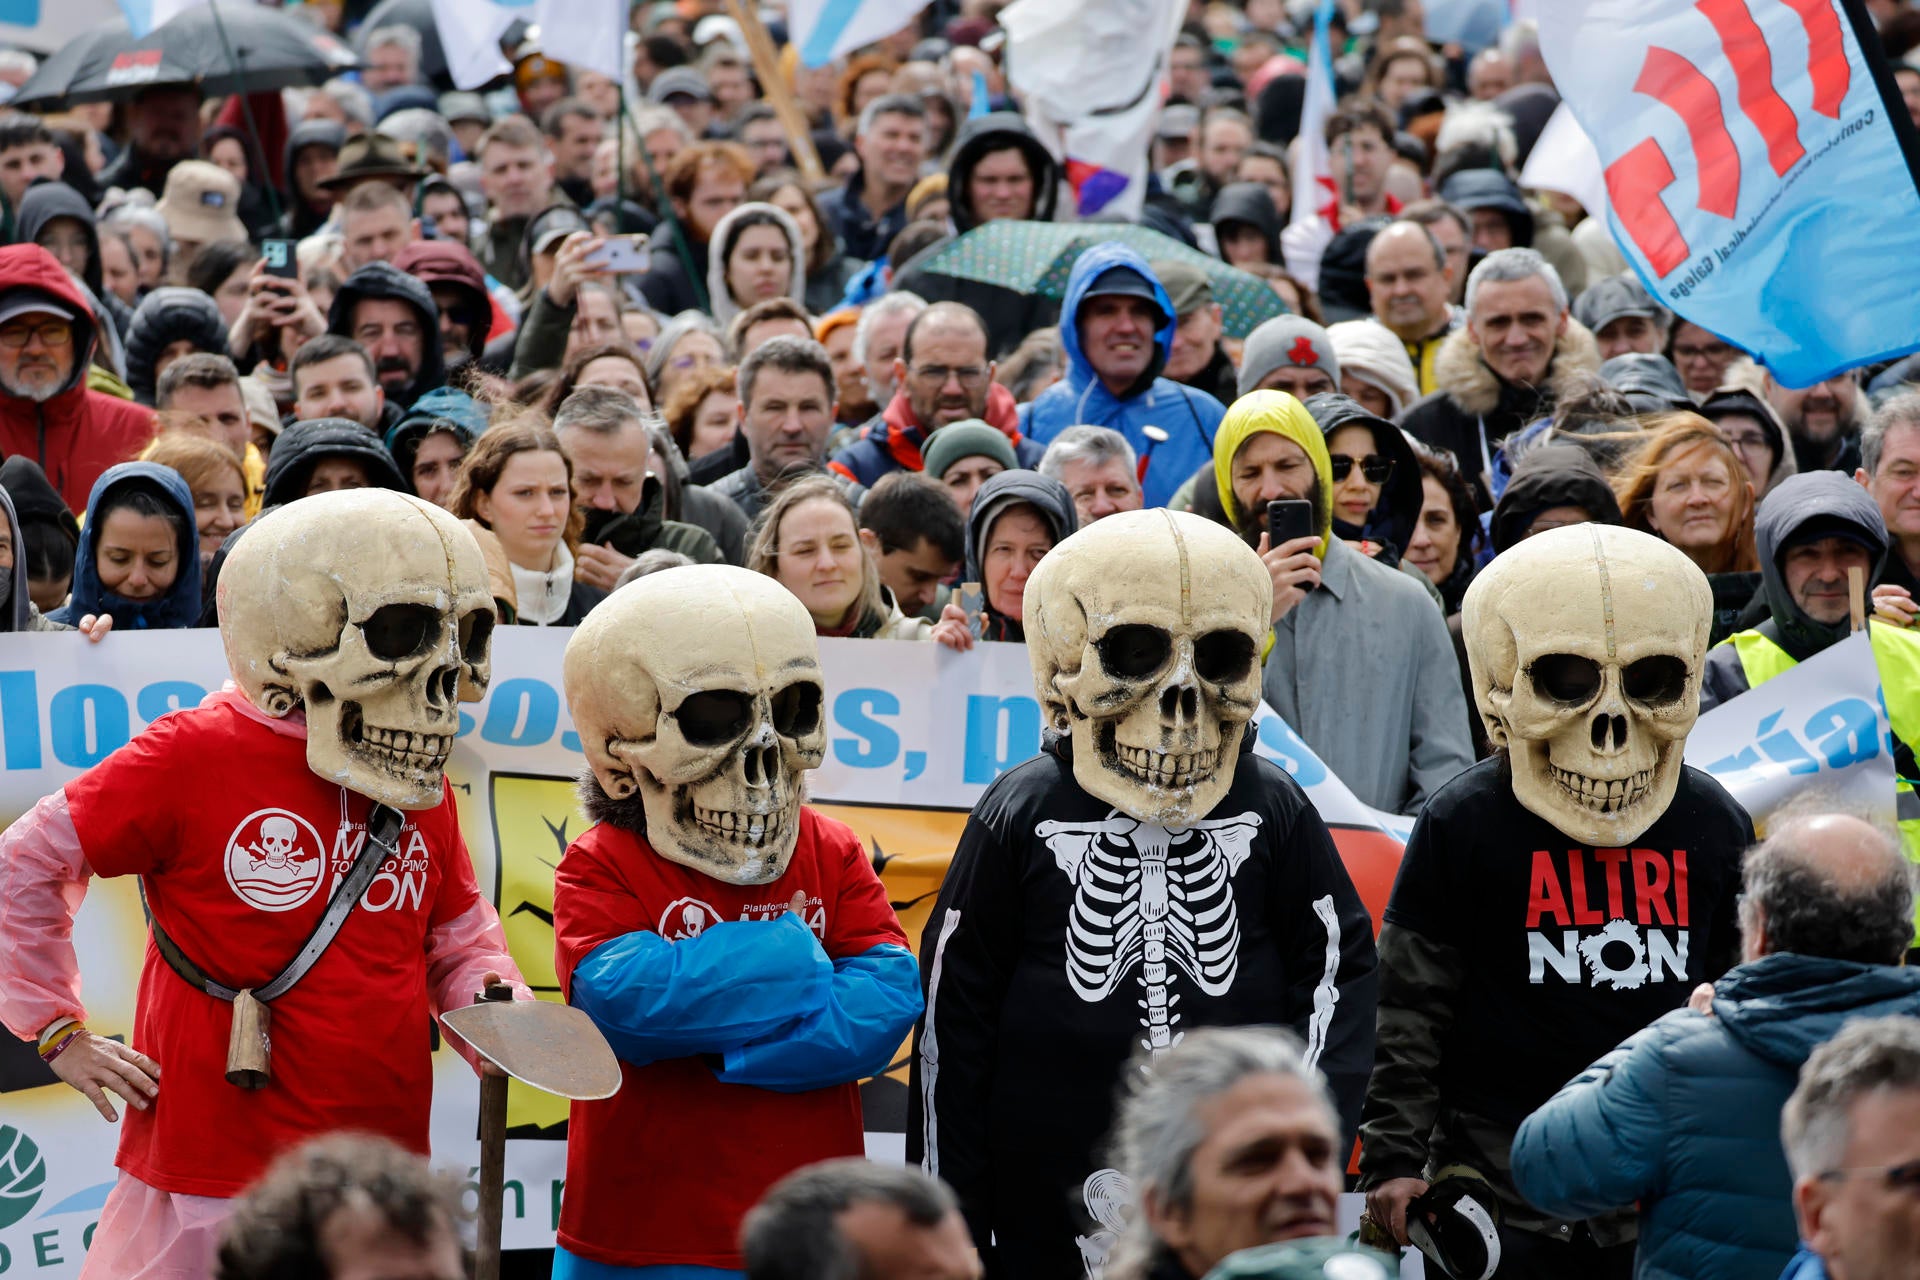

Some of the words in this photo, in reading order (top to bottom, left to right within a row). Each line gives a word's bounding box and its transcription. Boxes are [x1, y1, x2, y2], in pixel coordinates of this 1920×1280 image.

[331, 829, 429, 860] MA
[400, 859, 429, 872] PINO
[1525, 848, 1689, 928] ALTRI
[1527, 918, 1689, 991] NON
